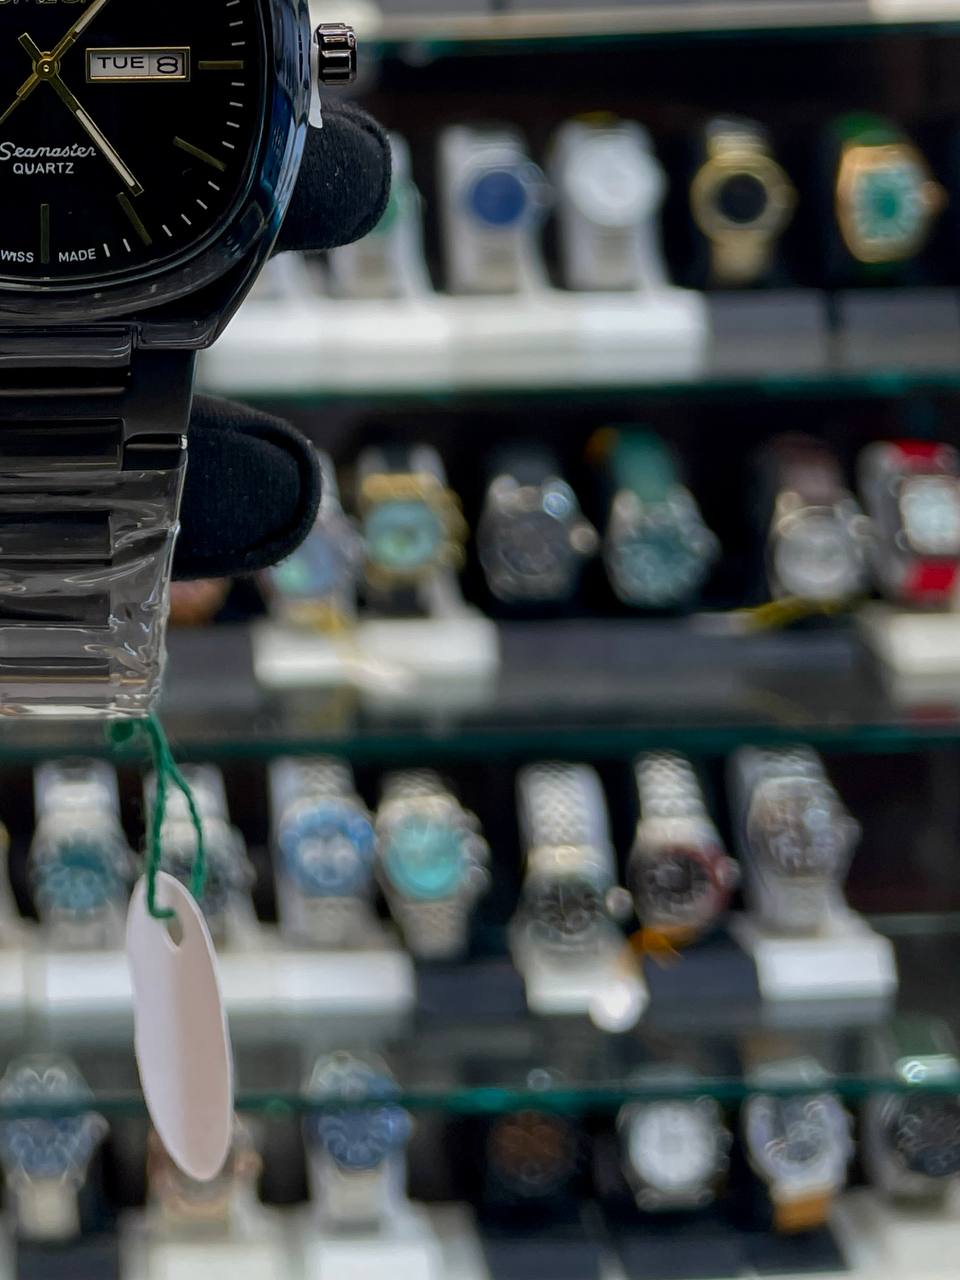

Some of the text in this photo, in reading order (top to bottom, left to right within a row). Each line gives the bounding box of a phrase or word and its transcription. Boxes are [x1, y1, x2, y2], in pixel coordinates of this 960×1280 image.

[97, 56, 178, 74] TUE 8
[12, 162, 75, 175] QUARTZ
[58, 248, 97, 262] MADE
